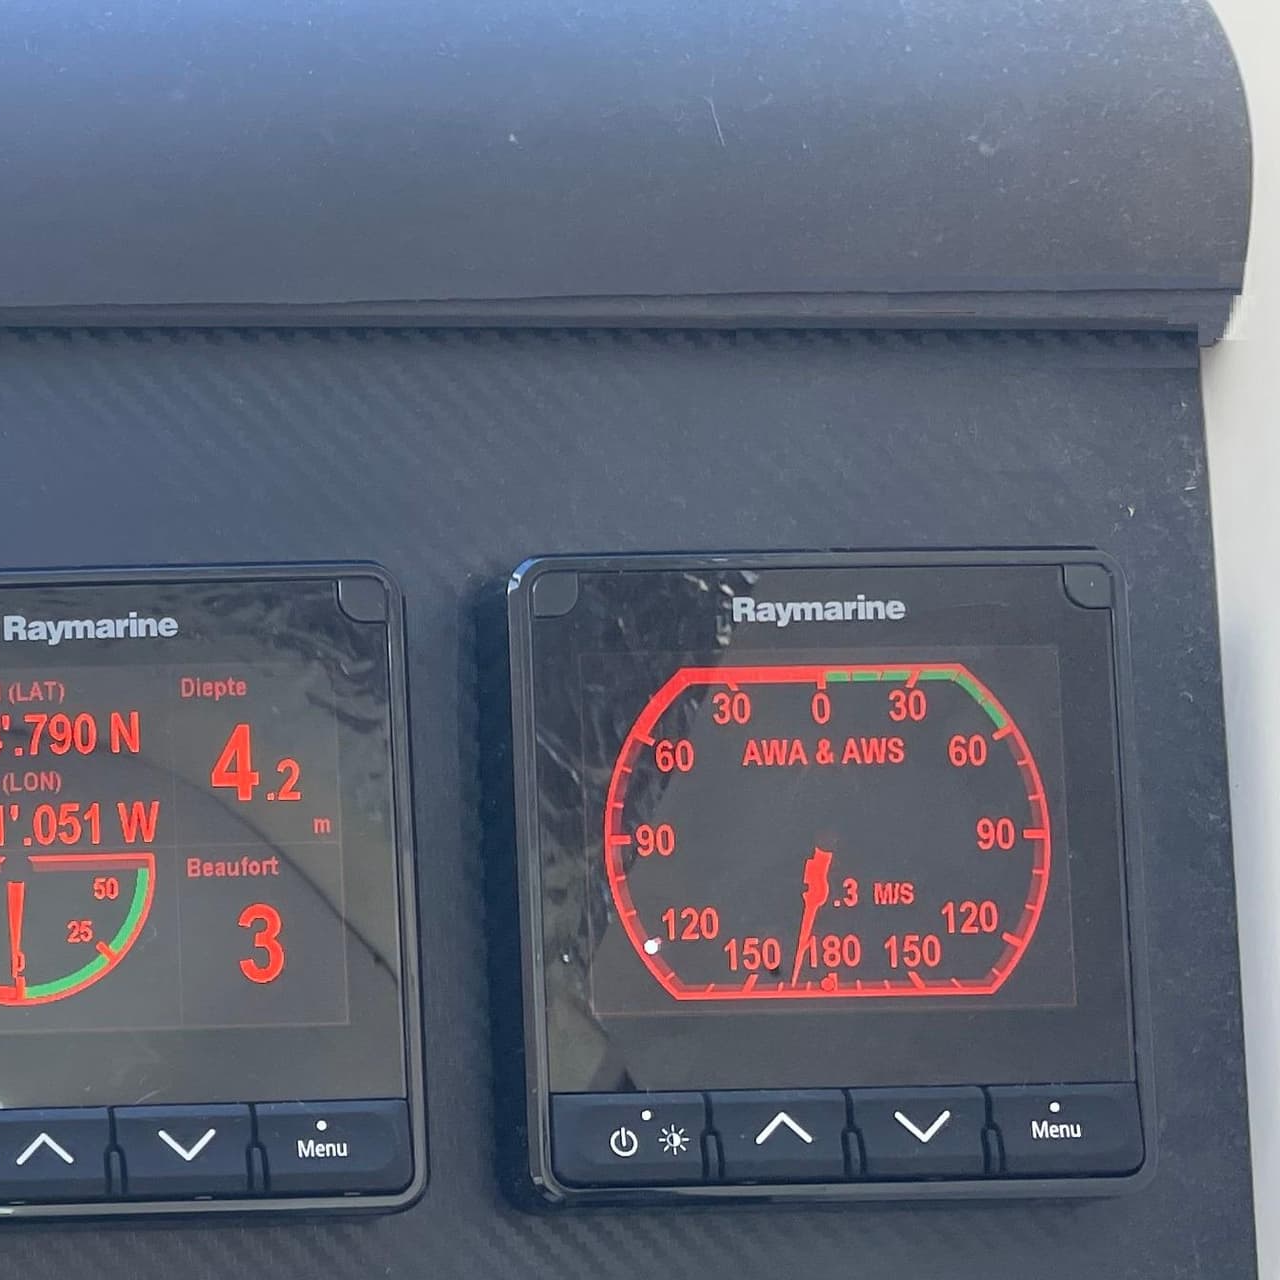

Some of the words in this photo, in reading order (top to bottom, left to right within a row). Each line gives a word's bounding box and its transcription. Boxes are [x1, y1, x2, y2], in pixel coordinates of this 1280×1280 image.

[732, 594, 906, 626] Raymarine
[3, 613, 179, 646] Raymarine
[8, 680, 65, 706] (LAT)
[180, 676, 247, 700] Diepte
[712, 693, 752, 725] 30
[811, 692, 831, 725] 0
[888, 689, 927, 722] 30
[110, 711, 140, 753] N
[655, 740, 694, 773] 60
[742, 738, 808, 766] AWA
[815, 738, 834, 765] &
[841, 736, 906, 765] AWS
[948, 734, 988, 766] 60
[1, 771, 62, 796] (LON)
[117, 801, 160, 844] W
[314, 814, 331, 834] m
[976, 817, 1015, 850] 90
[635, 824, 675, 857] 90
[186, 855, 280, 878] Beaufort
[93, 878, 120, 901] 50
[874, 882, 915, 905] M/S
[66, 920, 93, 944] 25
[661, 907, 719, 941] 120
[940, 901, 998, 935] 120
[238, 902, 286, 985] 3
[724, 937, 781, 971] 150
[807, 933, 861, 968] 180
[884, 934, 941, 968] 150
[1031, 1121, 1082, 1139] Menu
[297, 1139, 349, 1159] Menu
